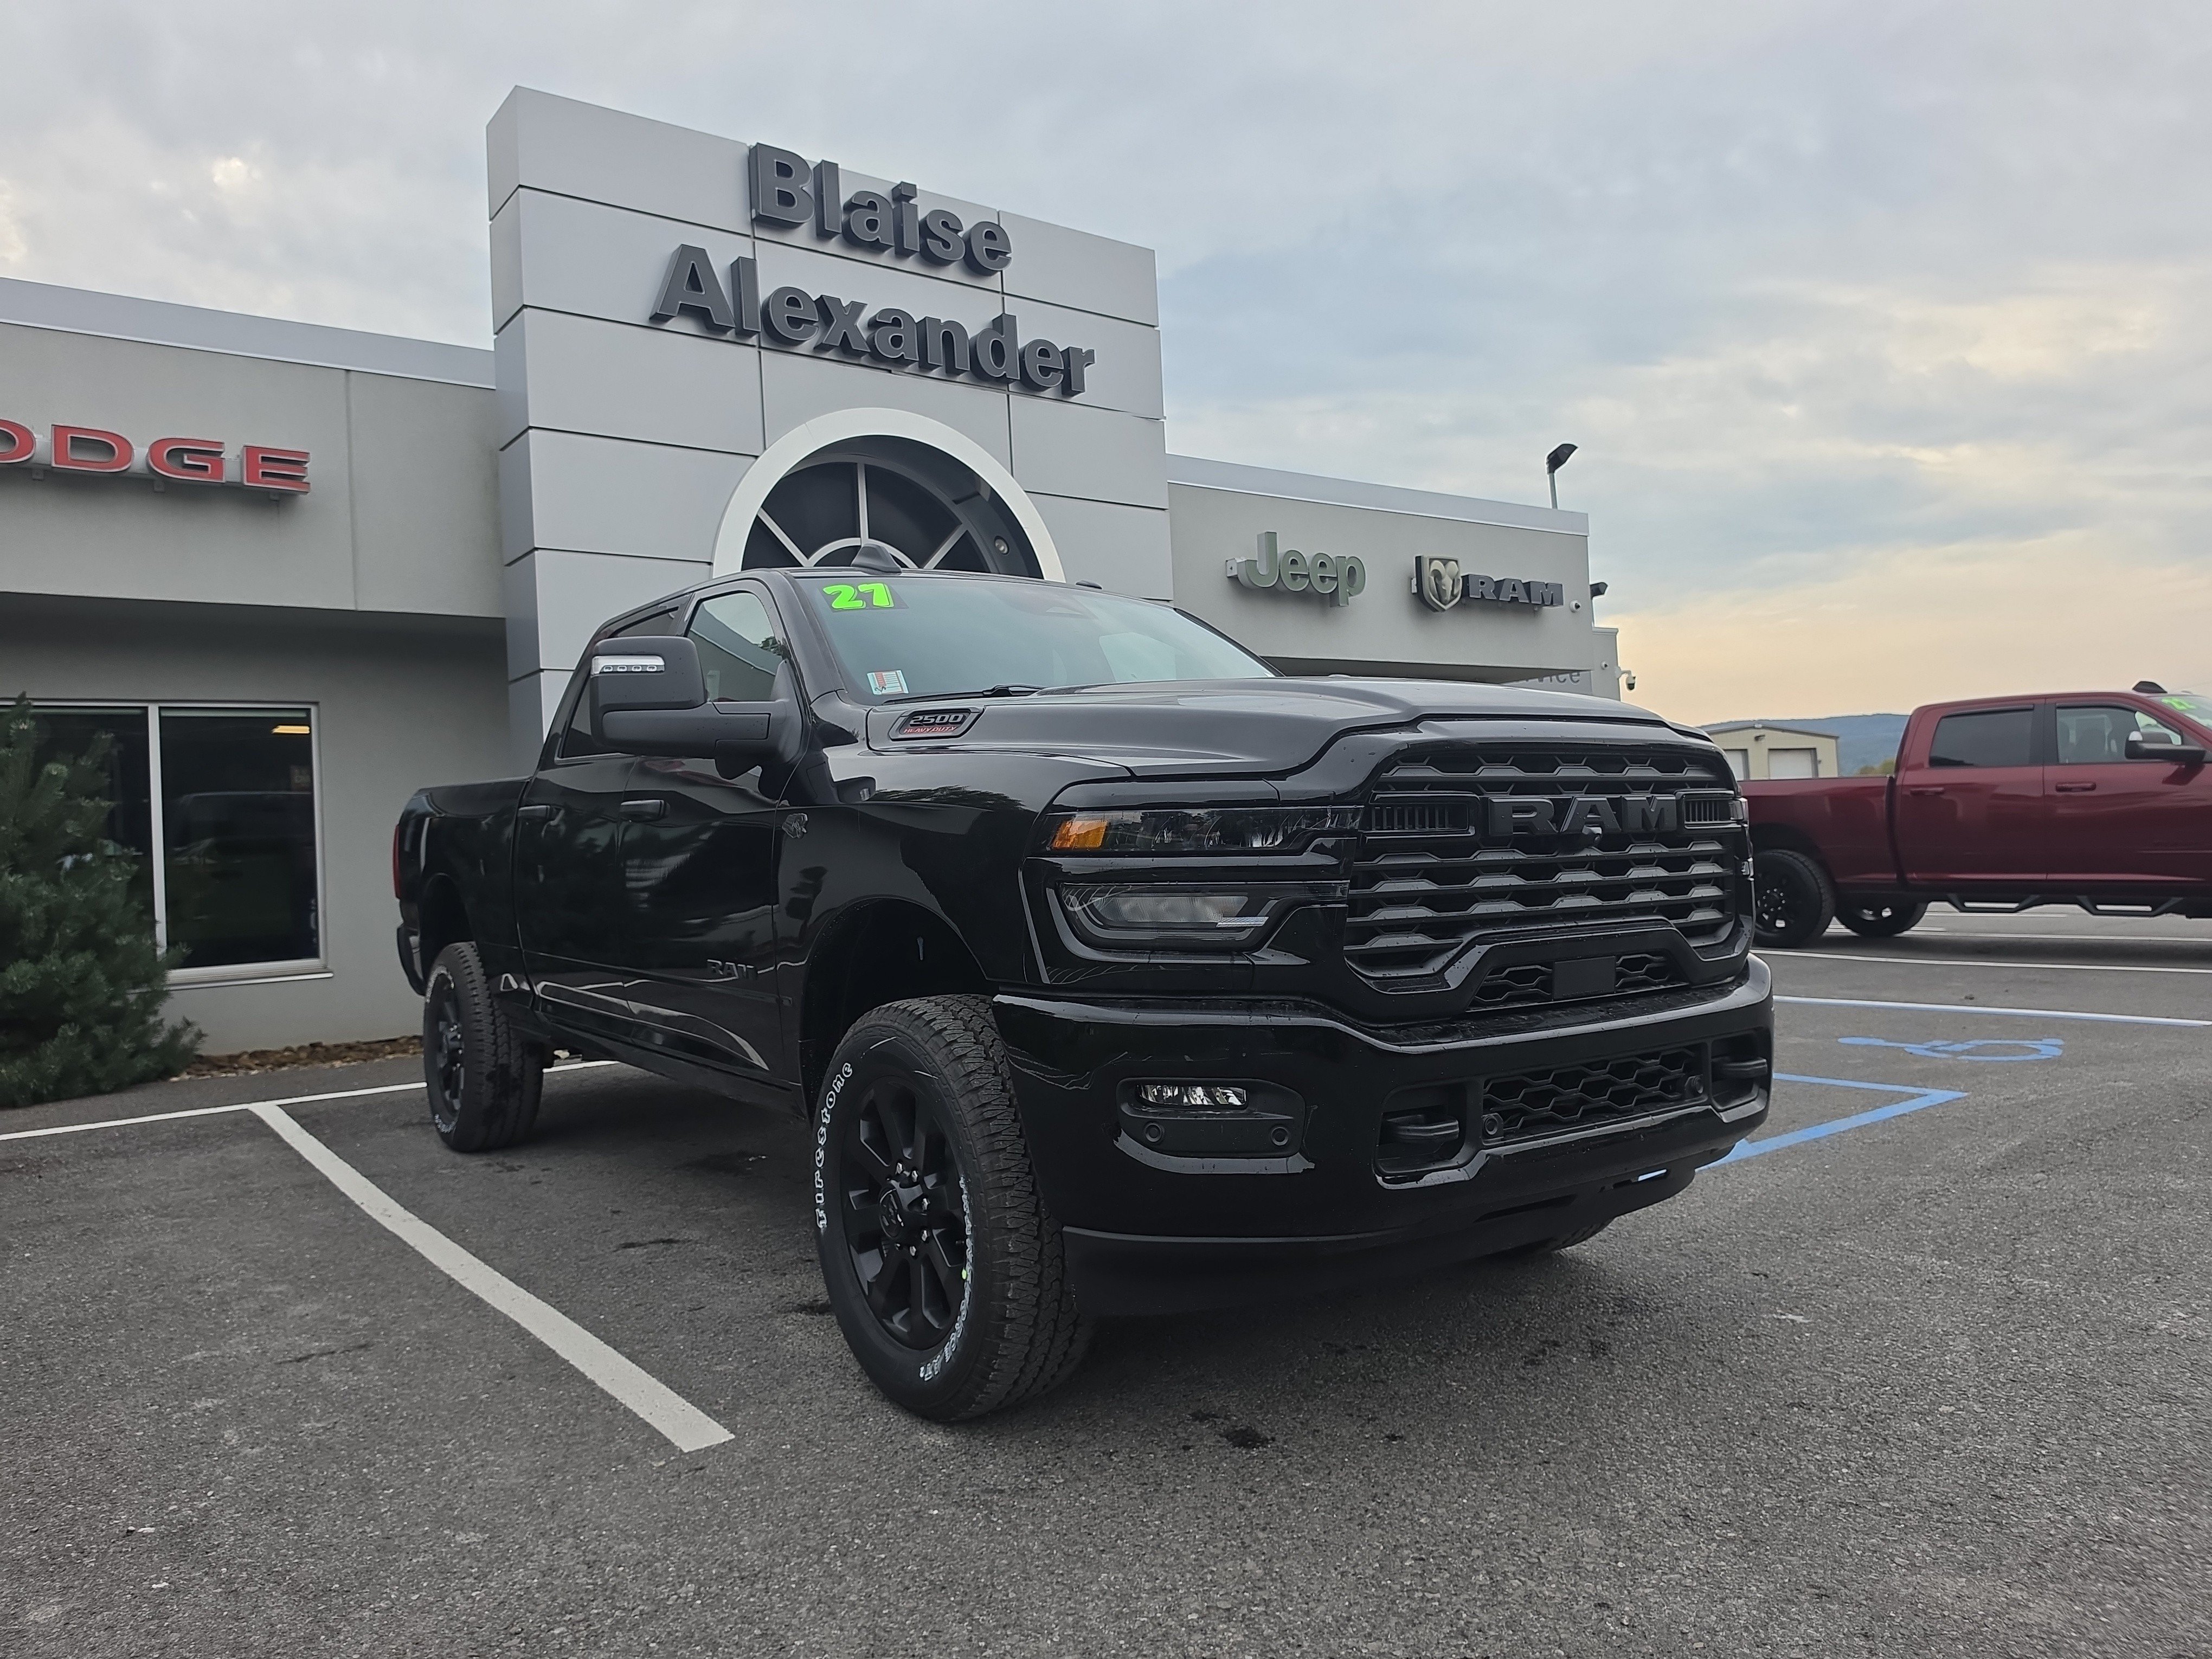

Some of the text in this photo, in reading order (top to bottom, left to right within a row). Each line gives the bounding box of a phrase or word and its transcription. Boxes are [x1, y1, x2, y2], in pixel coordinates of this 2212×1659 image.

[749, 142, 1013, 276] Blaise
[650, 243, 1095, 397] Alexander
[1237, 531, 1366, 607] Jeep
[822, 583, 895, 610] 27
[1464, 574, 1564, 606] RAM
[909, 714, 964, 726] 2500
[1488, 794, 1677, 835] RAM
